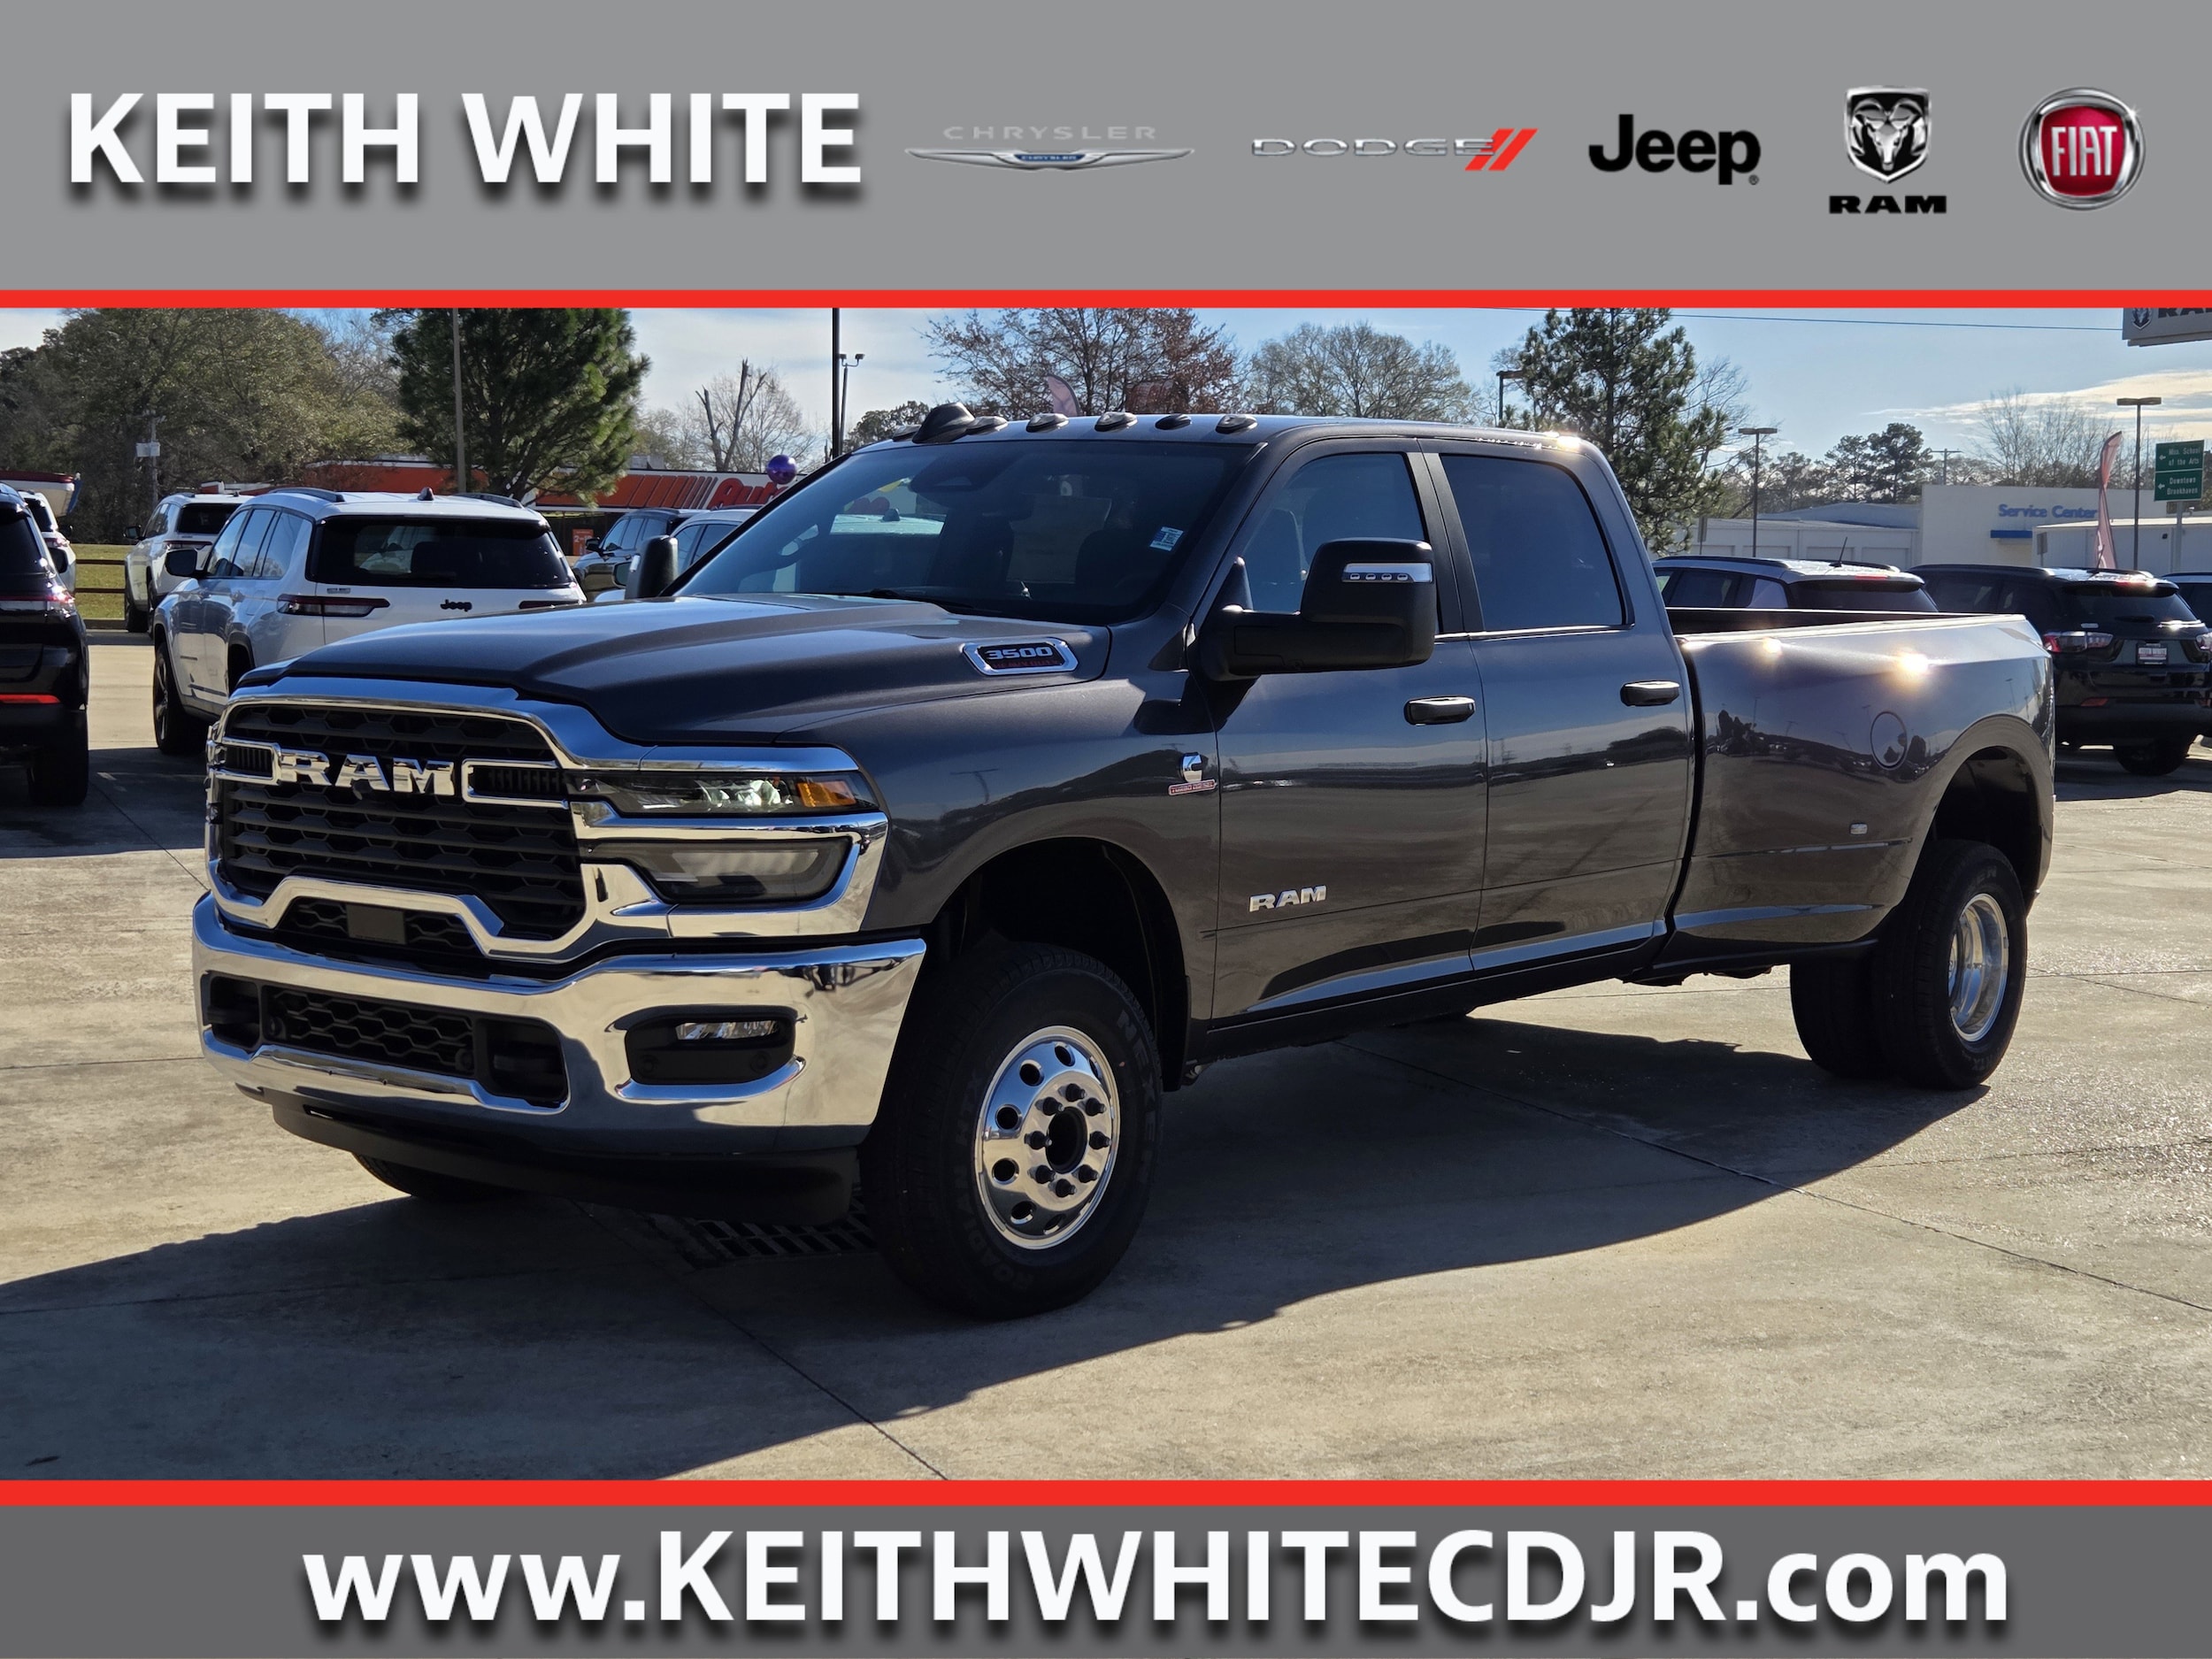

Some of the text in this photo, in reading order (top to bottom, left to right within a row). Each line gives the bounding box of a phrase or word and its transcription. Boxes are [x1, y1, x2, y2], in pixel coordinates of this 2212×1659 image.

[707, 478, 788, 510] Aut
[1998, 503, 2098, 518] Service Center
[441, 599, 472, 612] Jeep
[986, 646, 1053, 660] 3500
[279, 748, 455, 796] RAM
[1249, 885, 1326, 911] RAM
